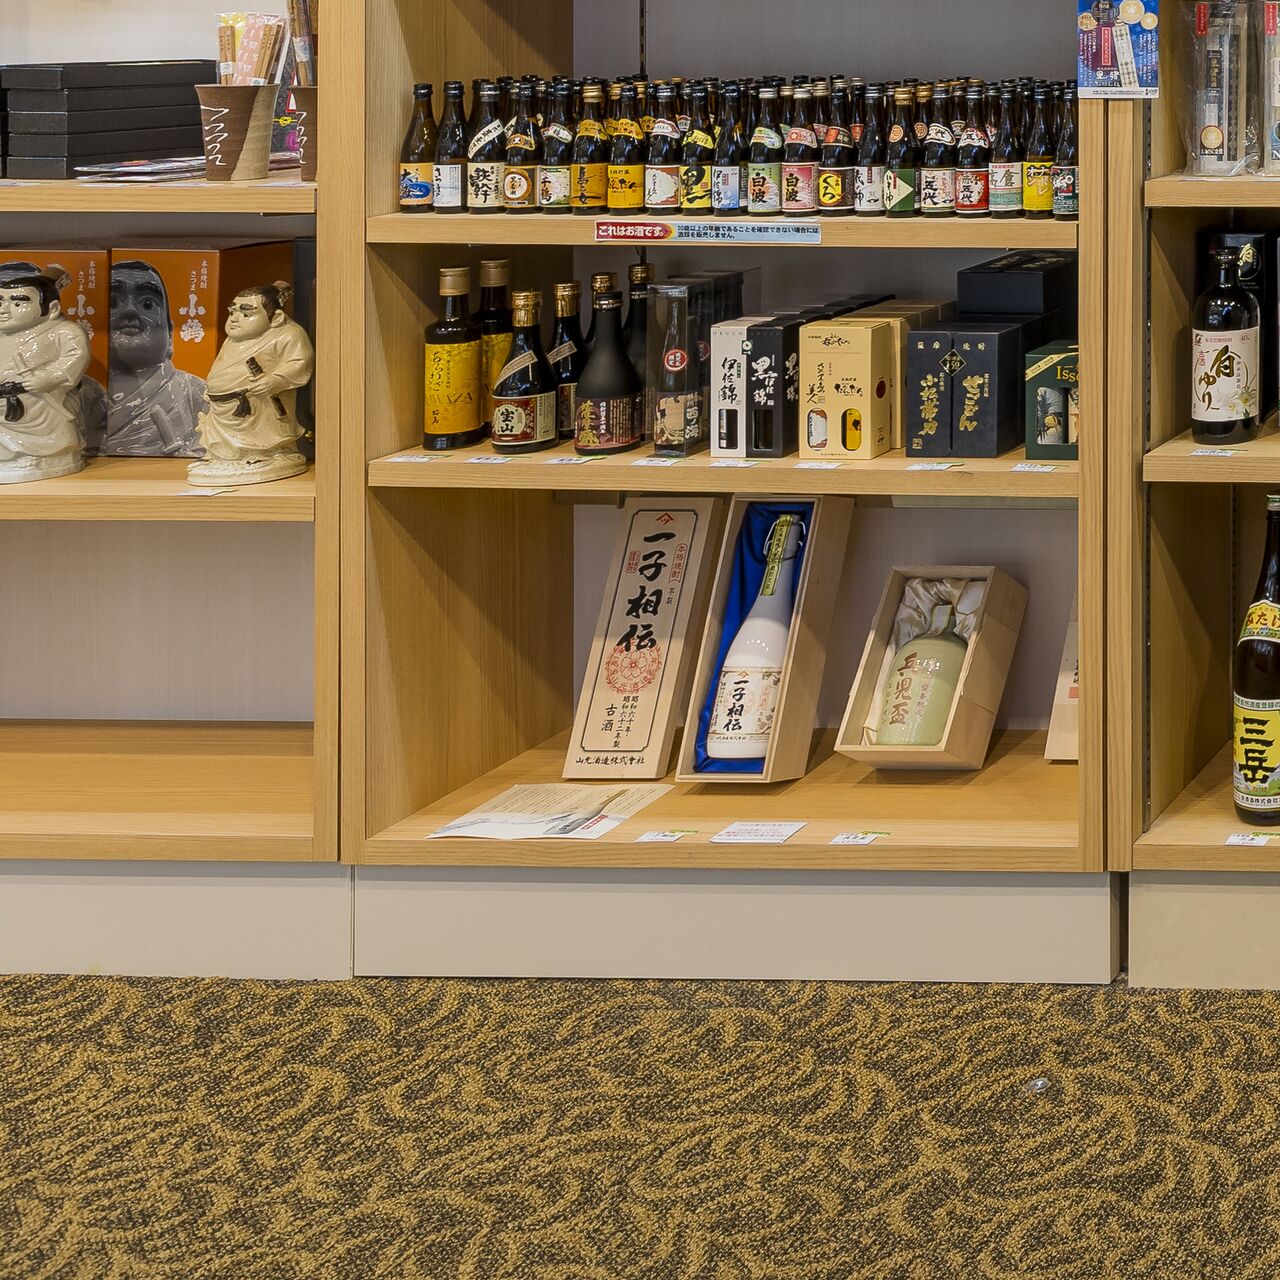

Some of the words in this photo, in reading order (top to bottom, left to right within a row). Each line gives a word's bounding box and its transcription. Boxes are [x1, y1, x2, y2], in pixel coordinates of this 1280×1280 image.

[752, 173, 767, 204] 白波
[784, 173, 800, 203] 白波
[922, 181, 938, 205] 五代
[598, 224, 666, 237] これはお酒です。
[178, 293, 206, 343] 小鶴
[720, 357, 738, 404] 伊佐錦
[498, 409, 513, 434] 宝山
[616, 530, 677, 654] 一子相伝
[722, 678, 750, 732] 一子相伝
[887, 652, 919, 727] 兵児盃
[600, 704, 618, 732] 古酒
[1239, 717, 1276, 782] 三岳
